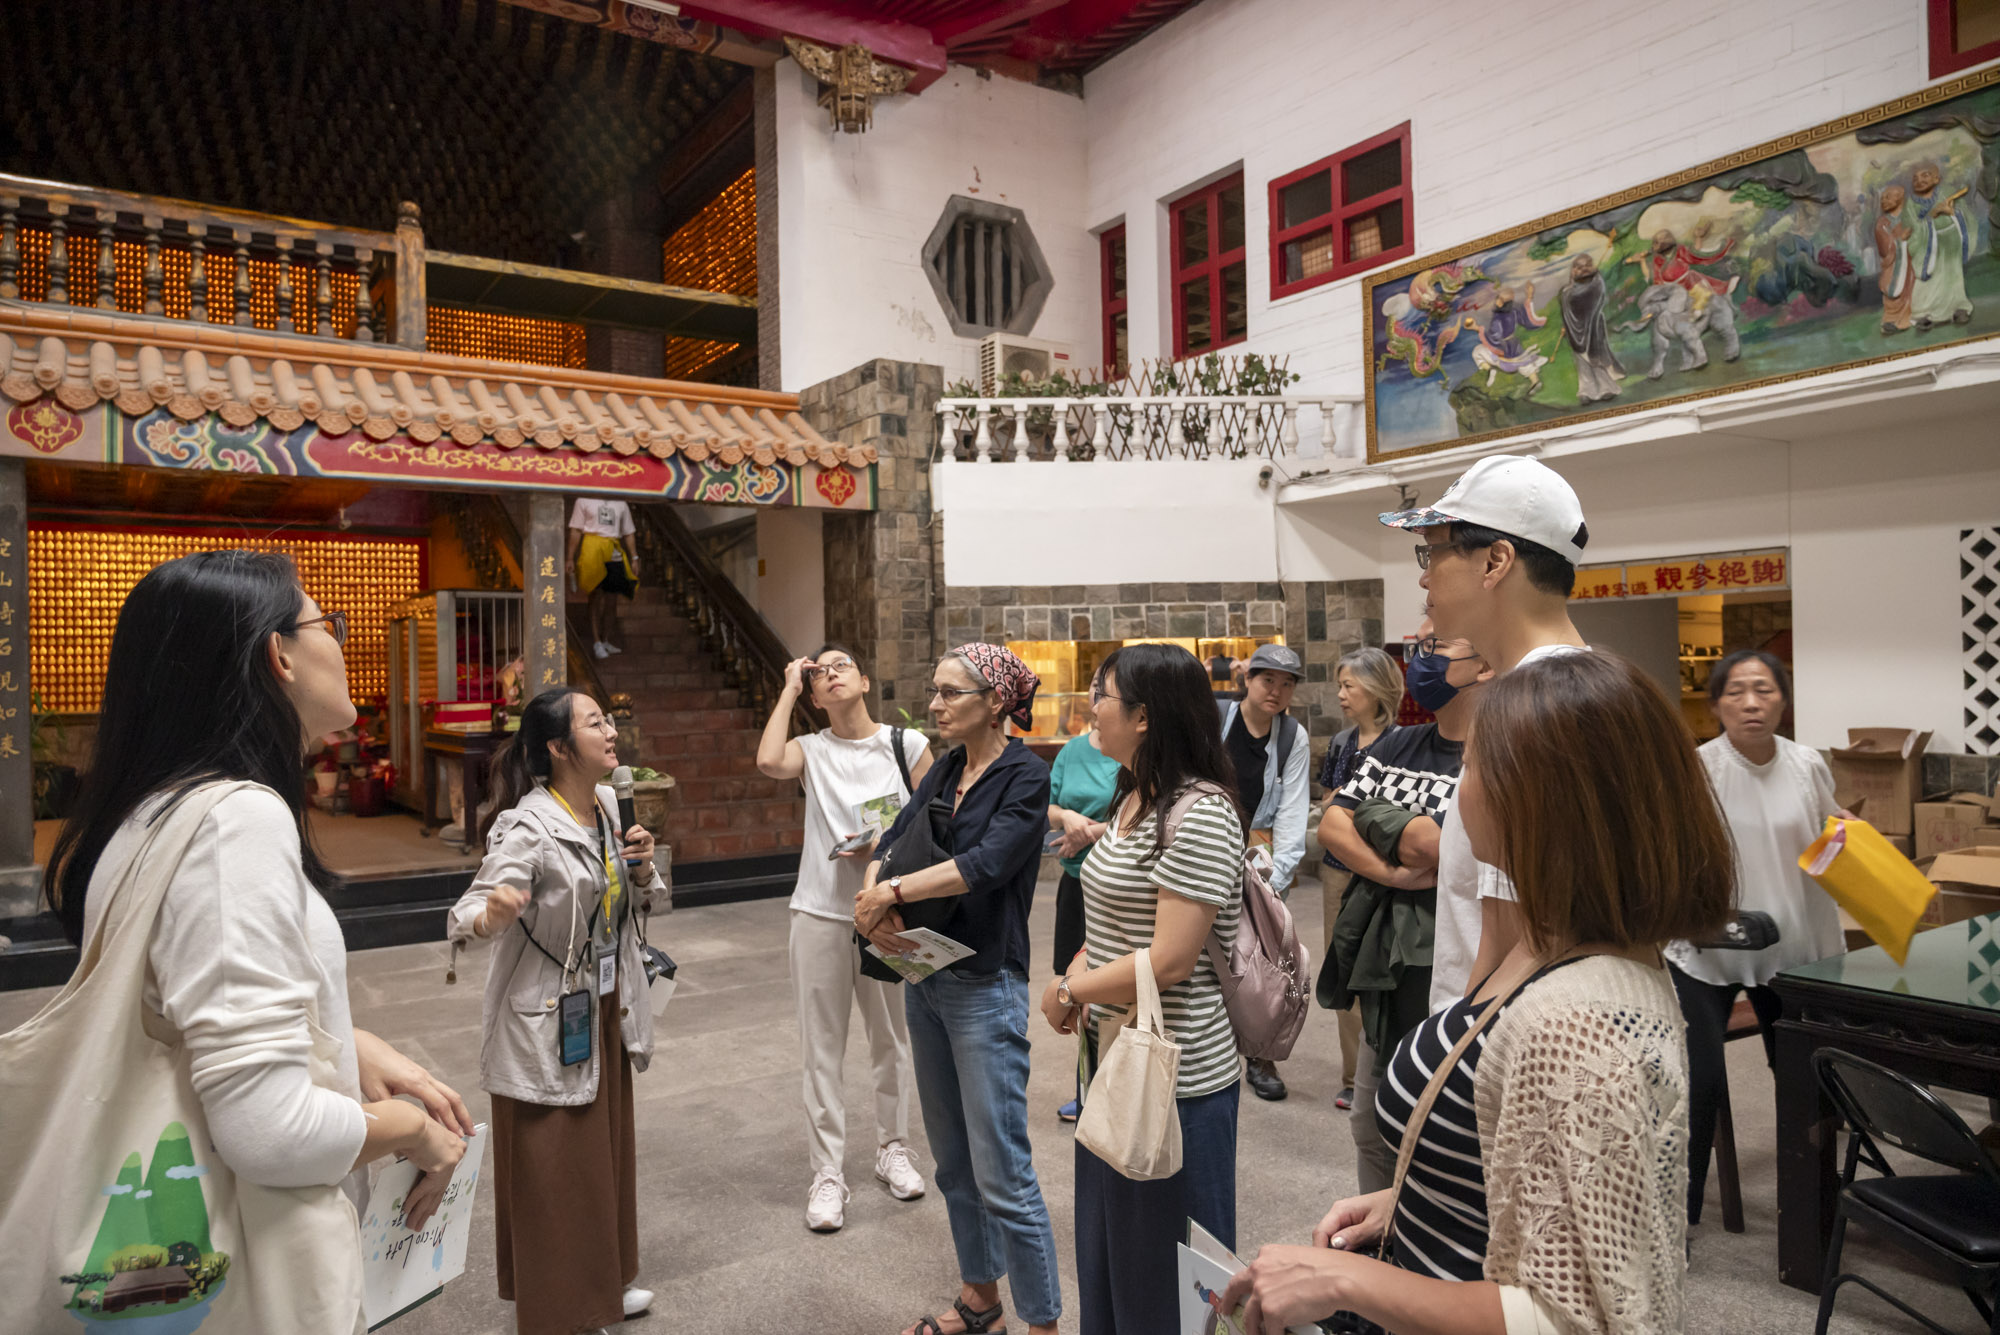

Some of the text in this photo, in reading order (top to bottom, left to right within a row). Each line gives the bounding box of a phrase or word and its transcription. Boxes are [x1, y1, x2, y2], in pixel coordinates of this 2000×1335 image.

[1653, 557, 1786, 591] 謝絕參觀
[1571, 581, 1649, 600] 遊客請止
